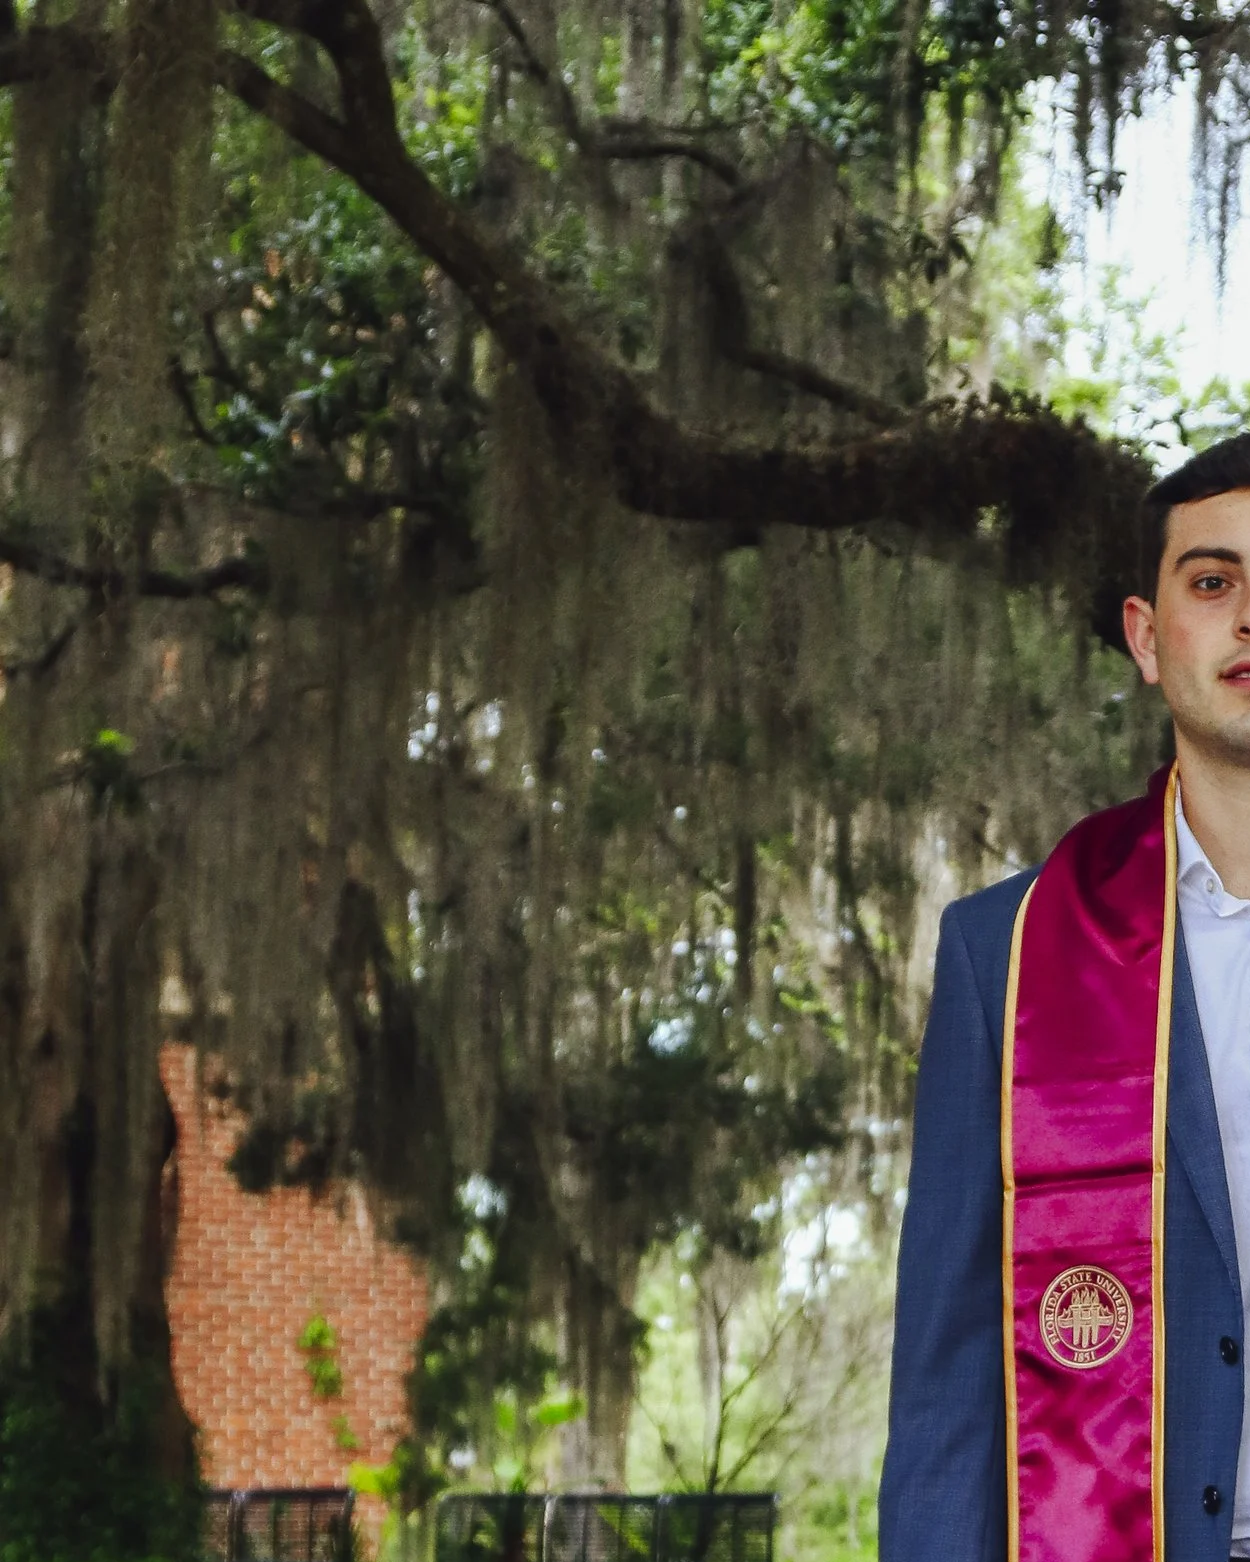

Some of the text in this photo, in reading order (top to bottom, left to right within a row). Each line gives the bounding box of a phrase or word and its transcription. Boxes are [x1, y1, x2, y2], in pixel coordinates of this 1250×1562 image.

[1044, 1272, 1127, 1345] FLORIDA STATE UNIVERSITY
[1073, 1351, 1096, 1362] 1851
